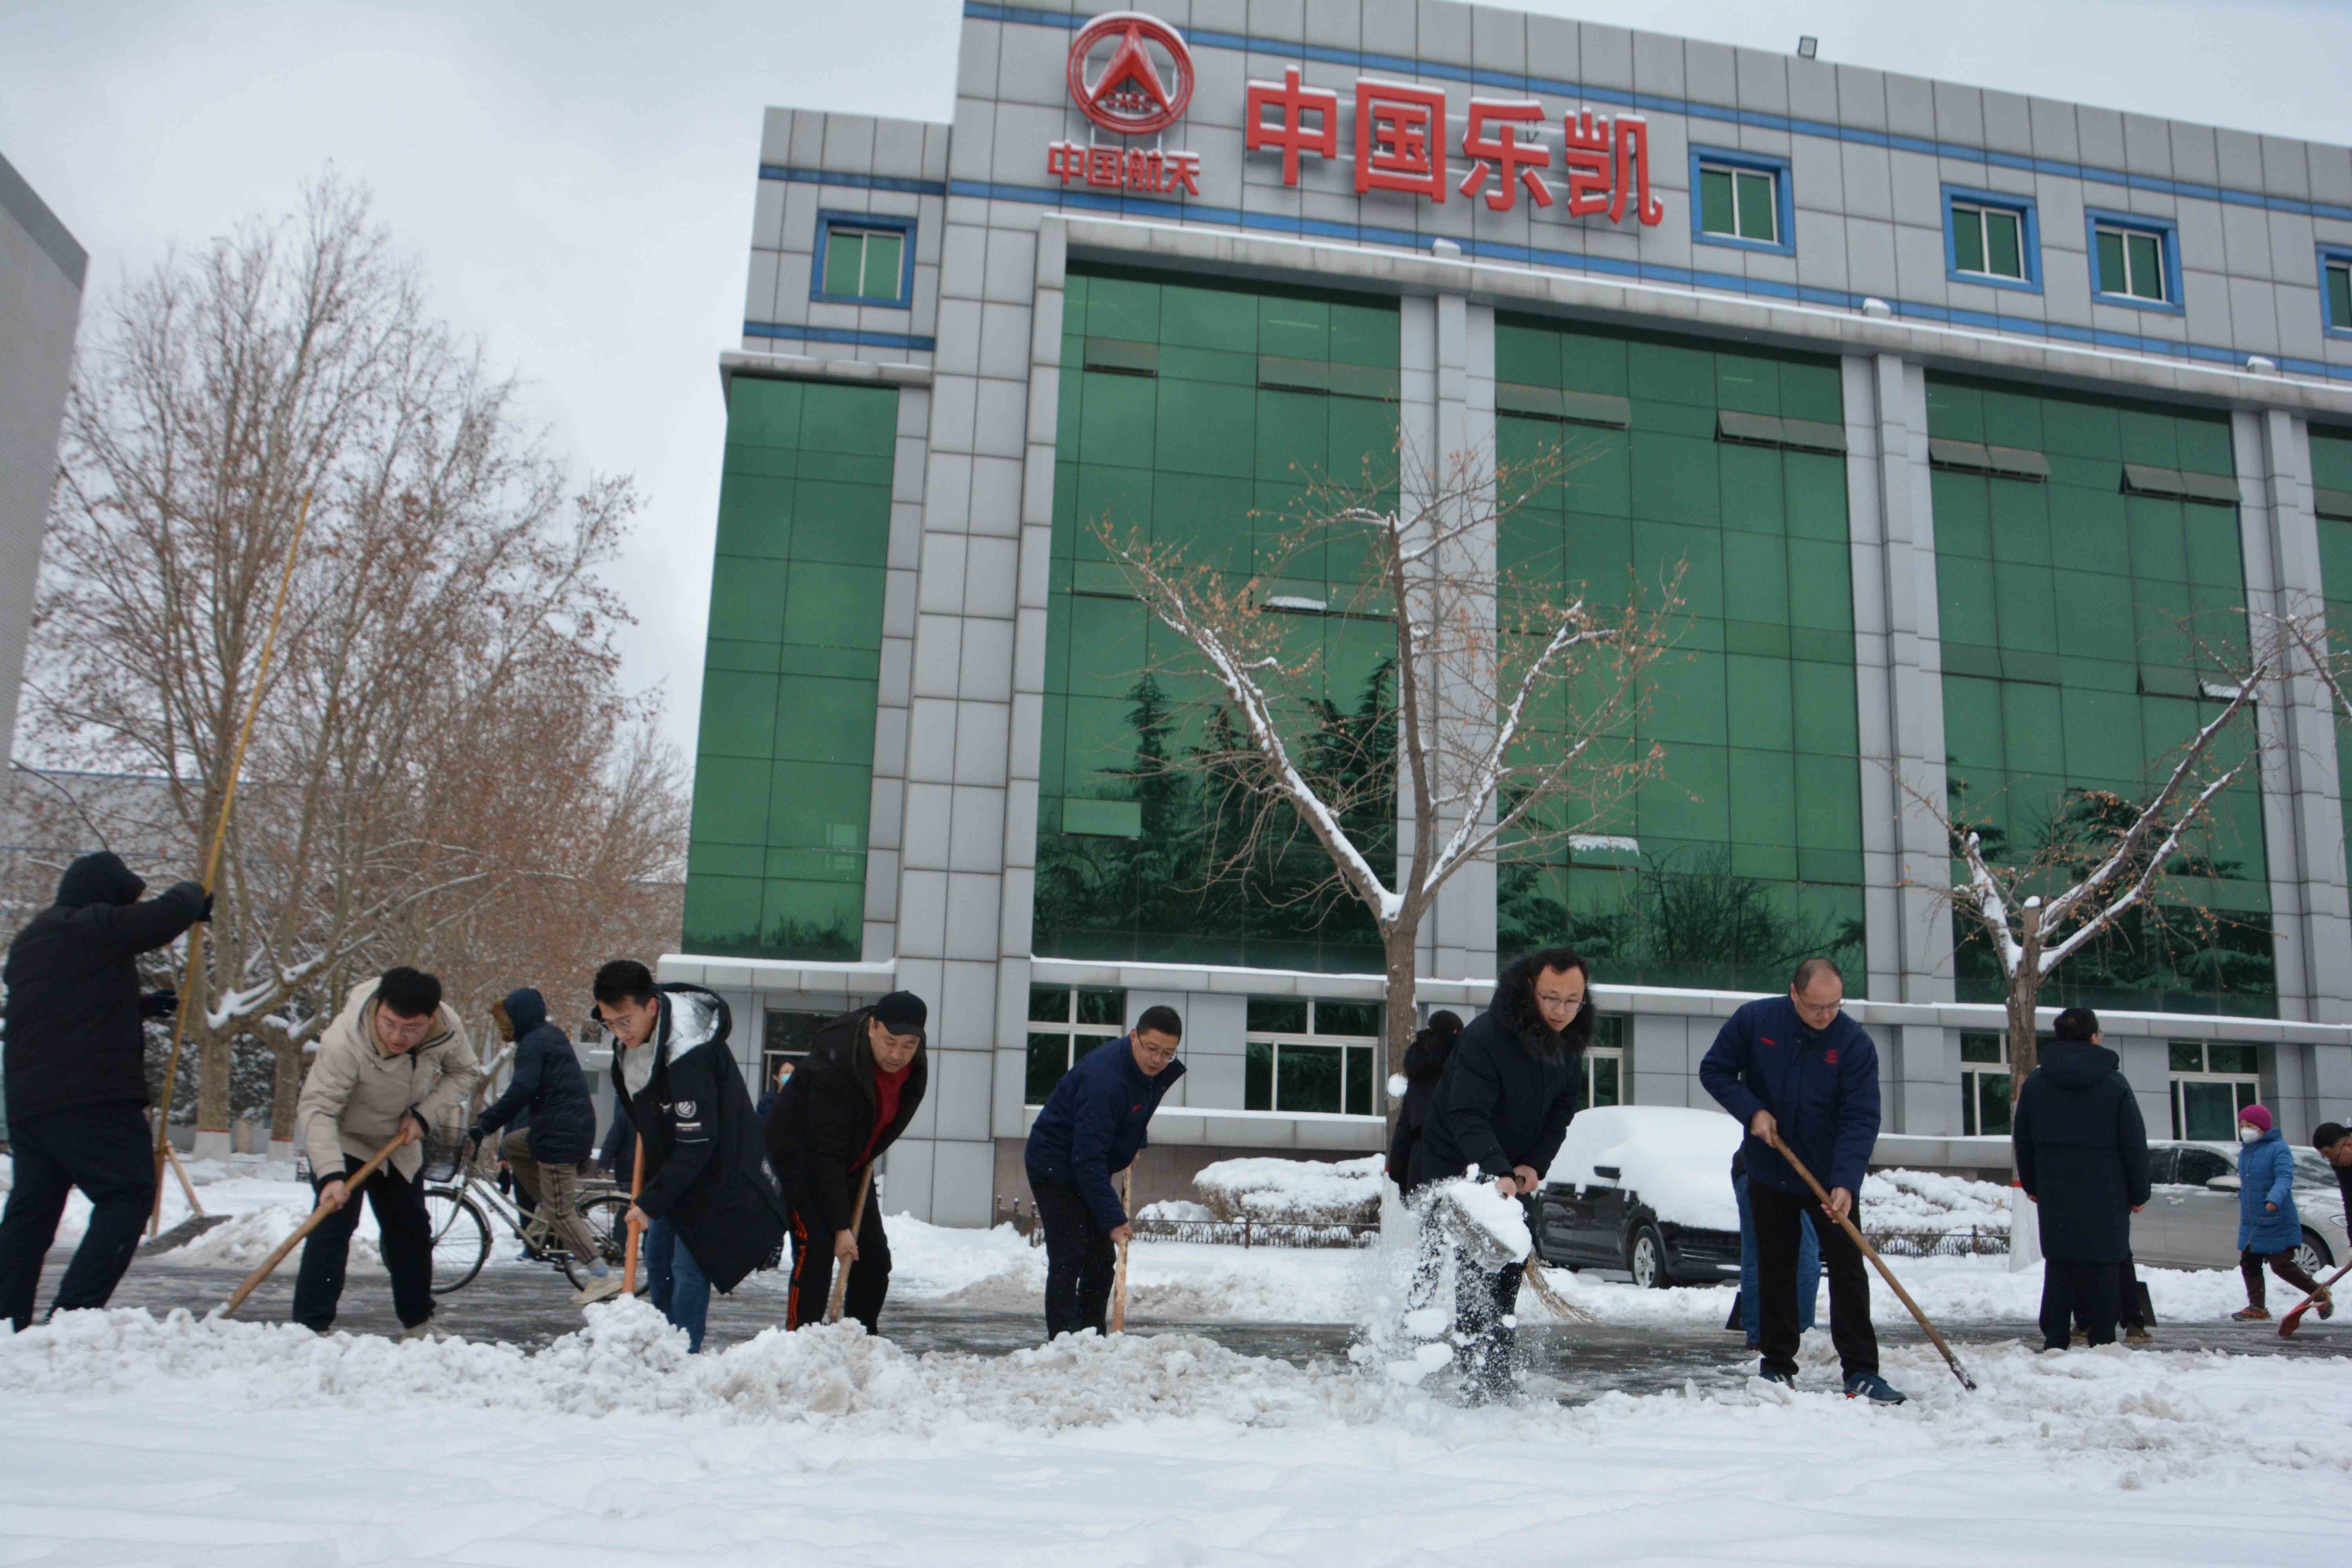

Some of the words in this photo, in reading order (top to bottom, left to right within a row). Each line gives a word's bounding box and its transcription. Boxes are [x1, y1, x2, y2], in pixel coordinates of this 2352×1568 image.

[1047, 140, 1200, 196] 中国航天
[1246, 65, 1663, 226] 中国乐凯
